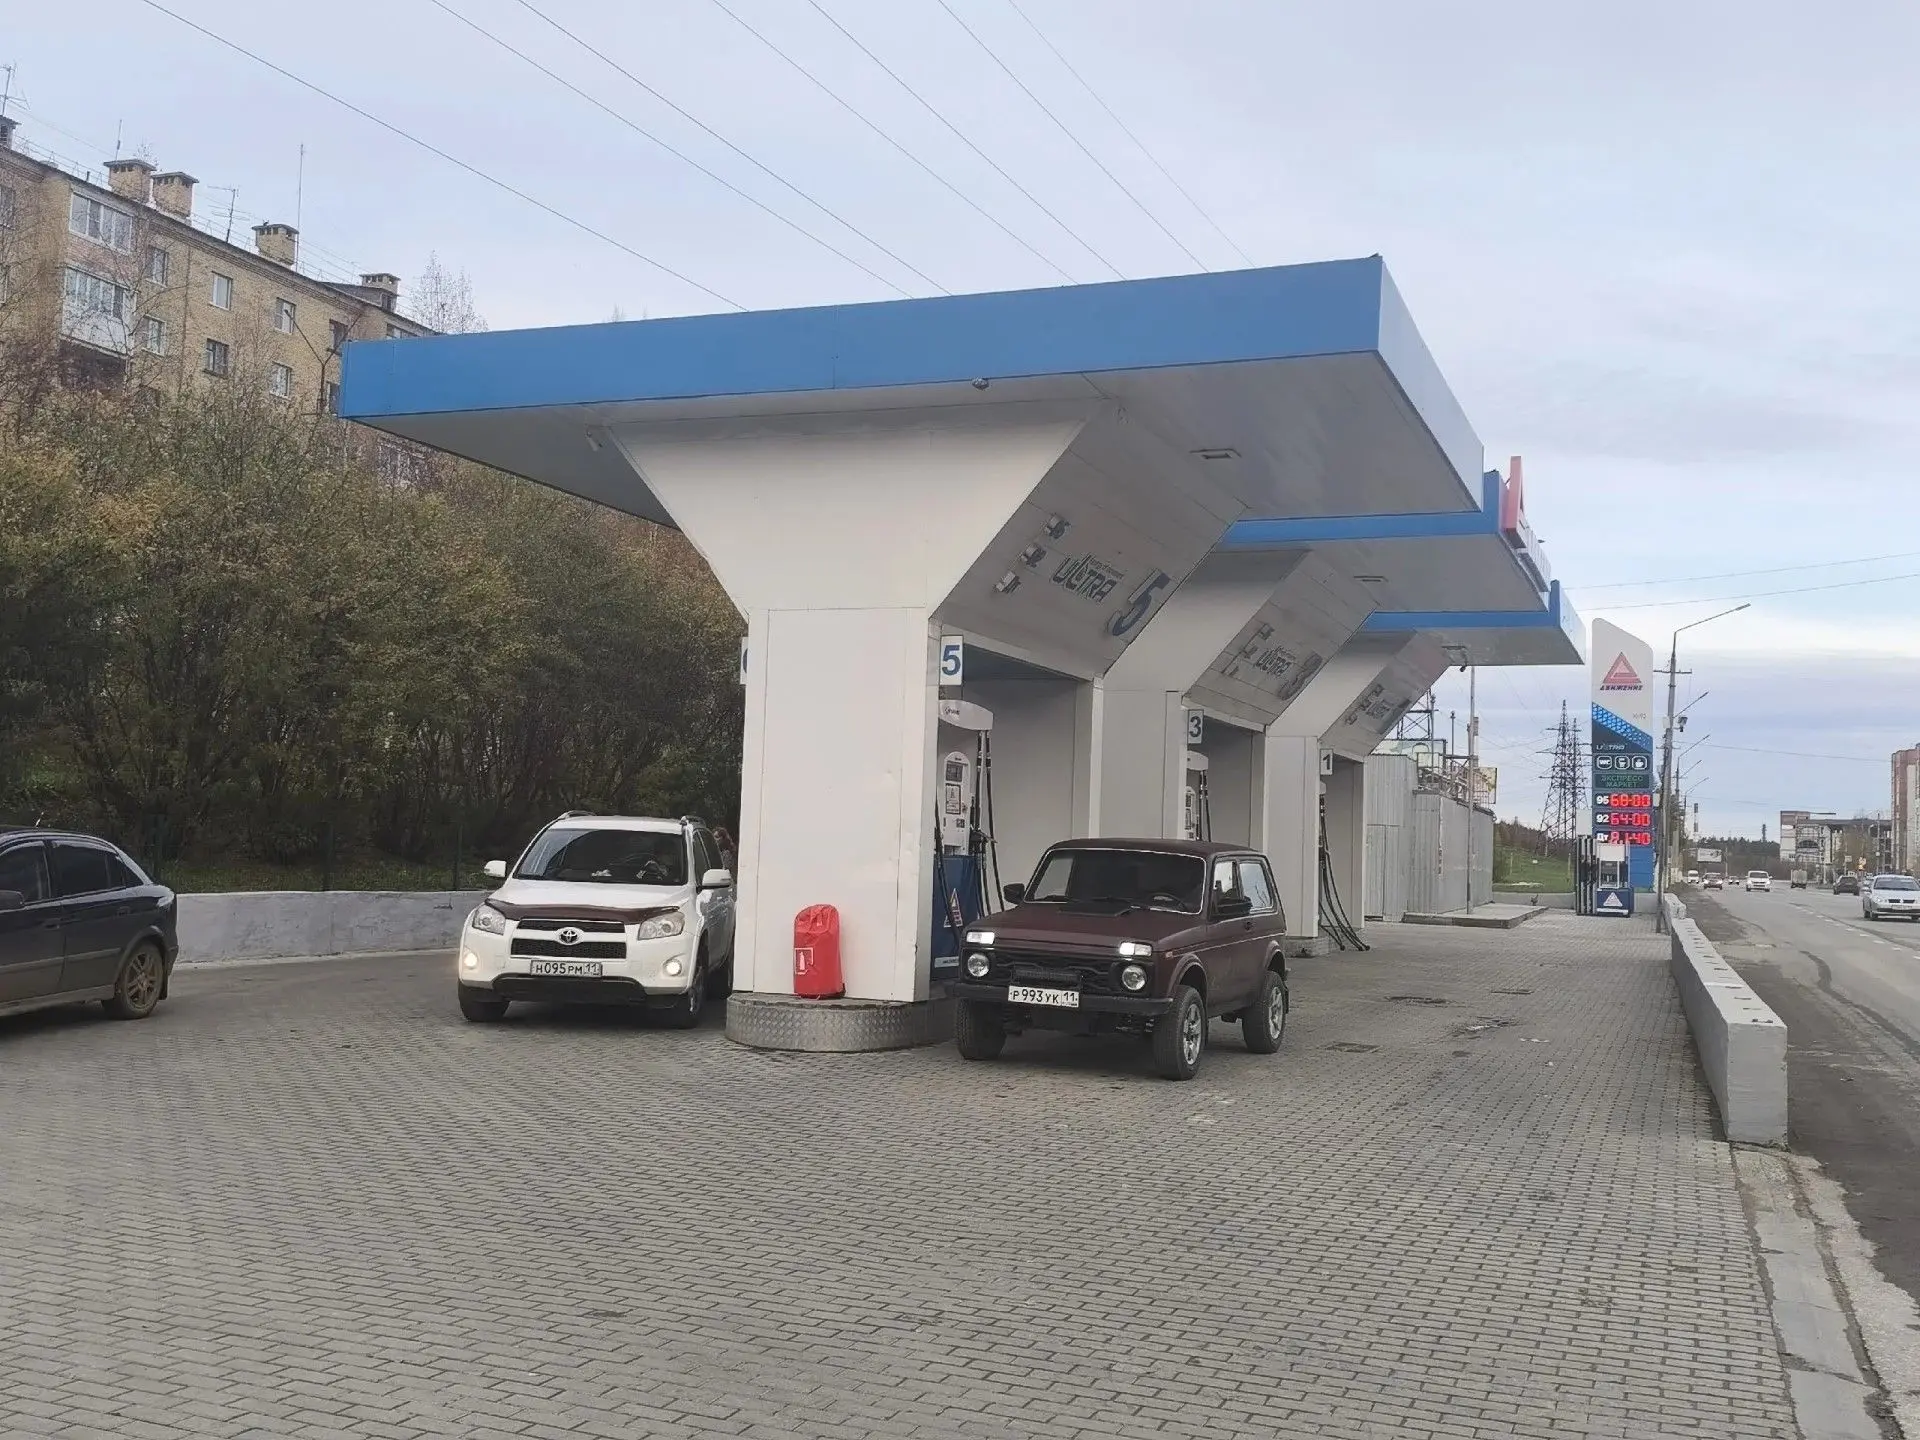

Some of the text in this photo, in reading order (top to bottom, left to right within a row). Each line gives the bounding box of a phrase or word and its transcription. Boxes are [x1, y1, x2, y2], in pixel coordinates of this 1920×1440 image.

[941, 644, 961, 676] 5
[1190, 715, 1202, 738] 3
[1322, 753, 1331, 771] 1
[1596, 795, 1609, 805] 95
[1596, 814, 1609, 823] 92
